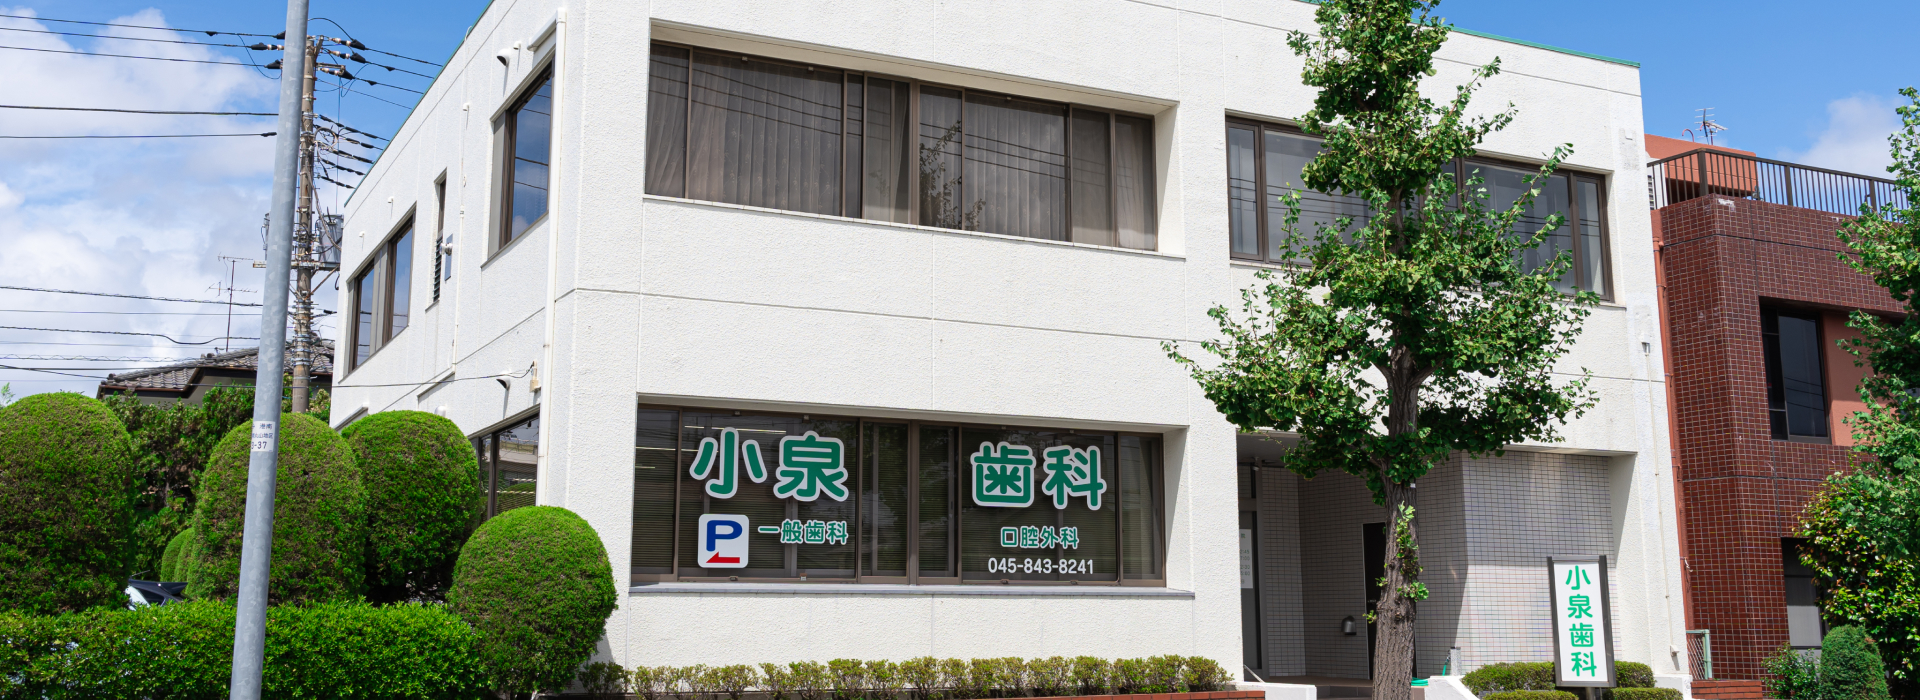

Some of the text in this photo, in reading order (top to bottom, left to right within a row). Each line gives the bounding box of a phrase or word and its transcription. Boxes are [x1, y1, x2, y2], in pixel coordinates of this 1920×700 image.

[689, 427, 1107, 510] 小泉 歯科
[706, 520, 743, 552] P
[758, 519, 848, 545] 一般歯科
[1001, 526, 1079, 549] 口腔外科
[988, 557, 1094, 574] 045-843-8241
[1565, 565, 1598, 677] 小泉歯科
